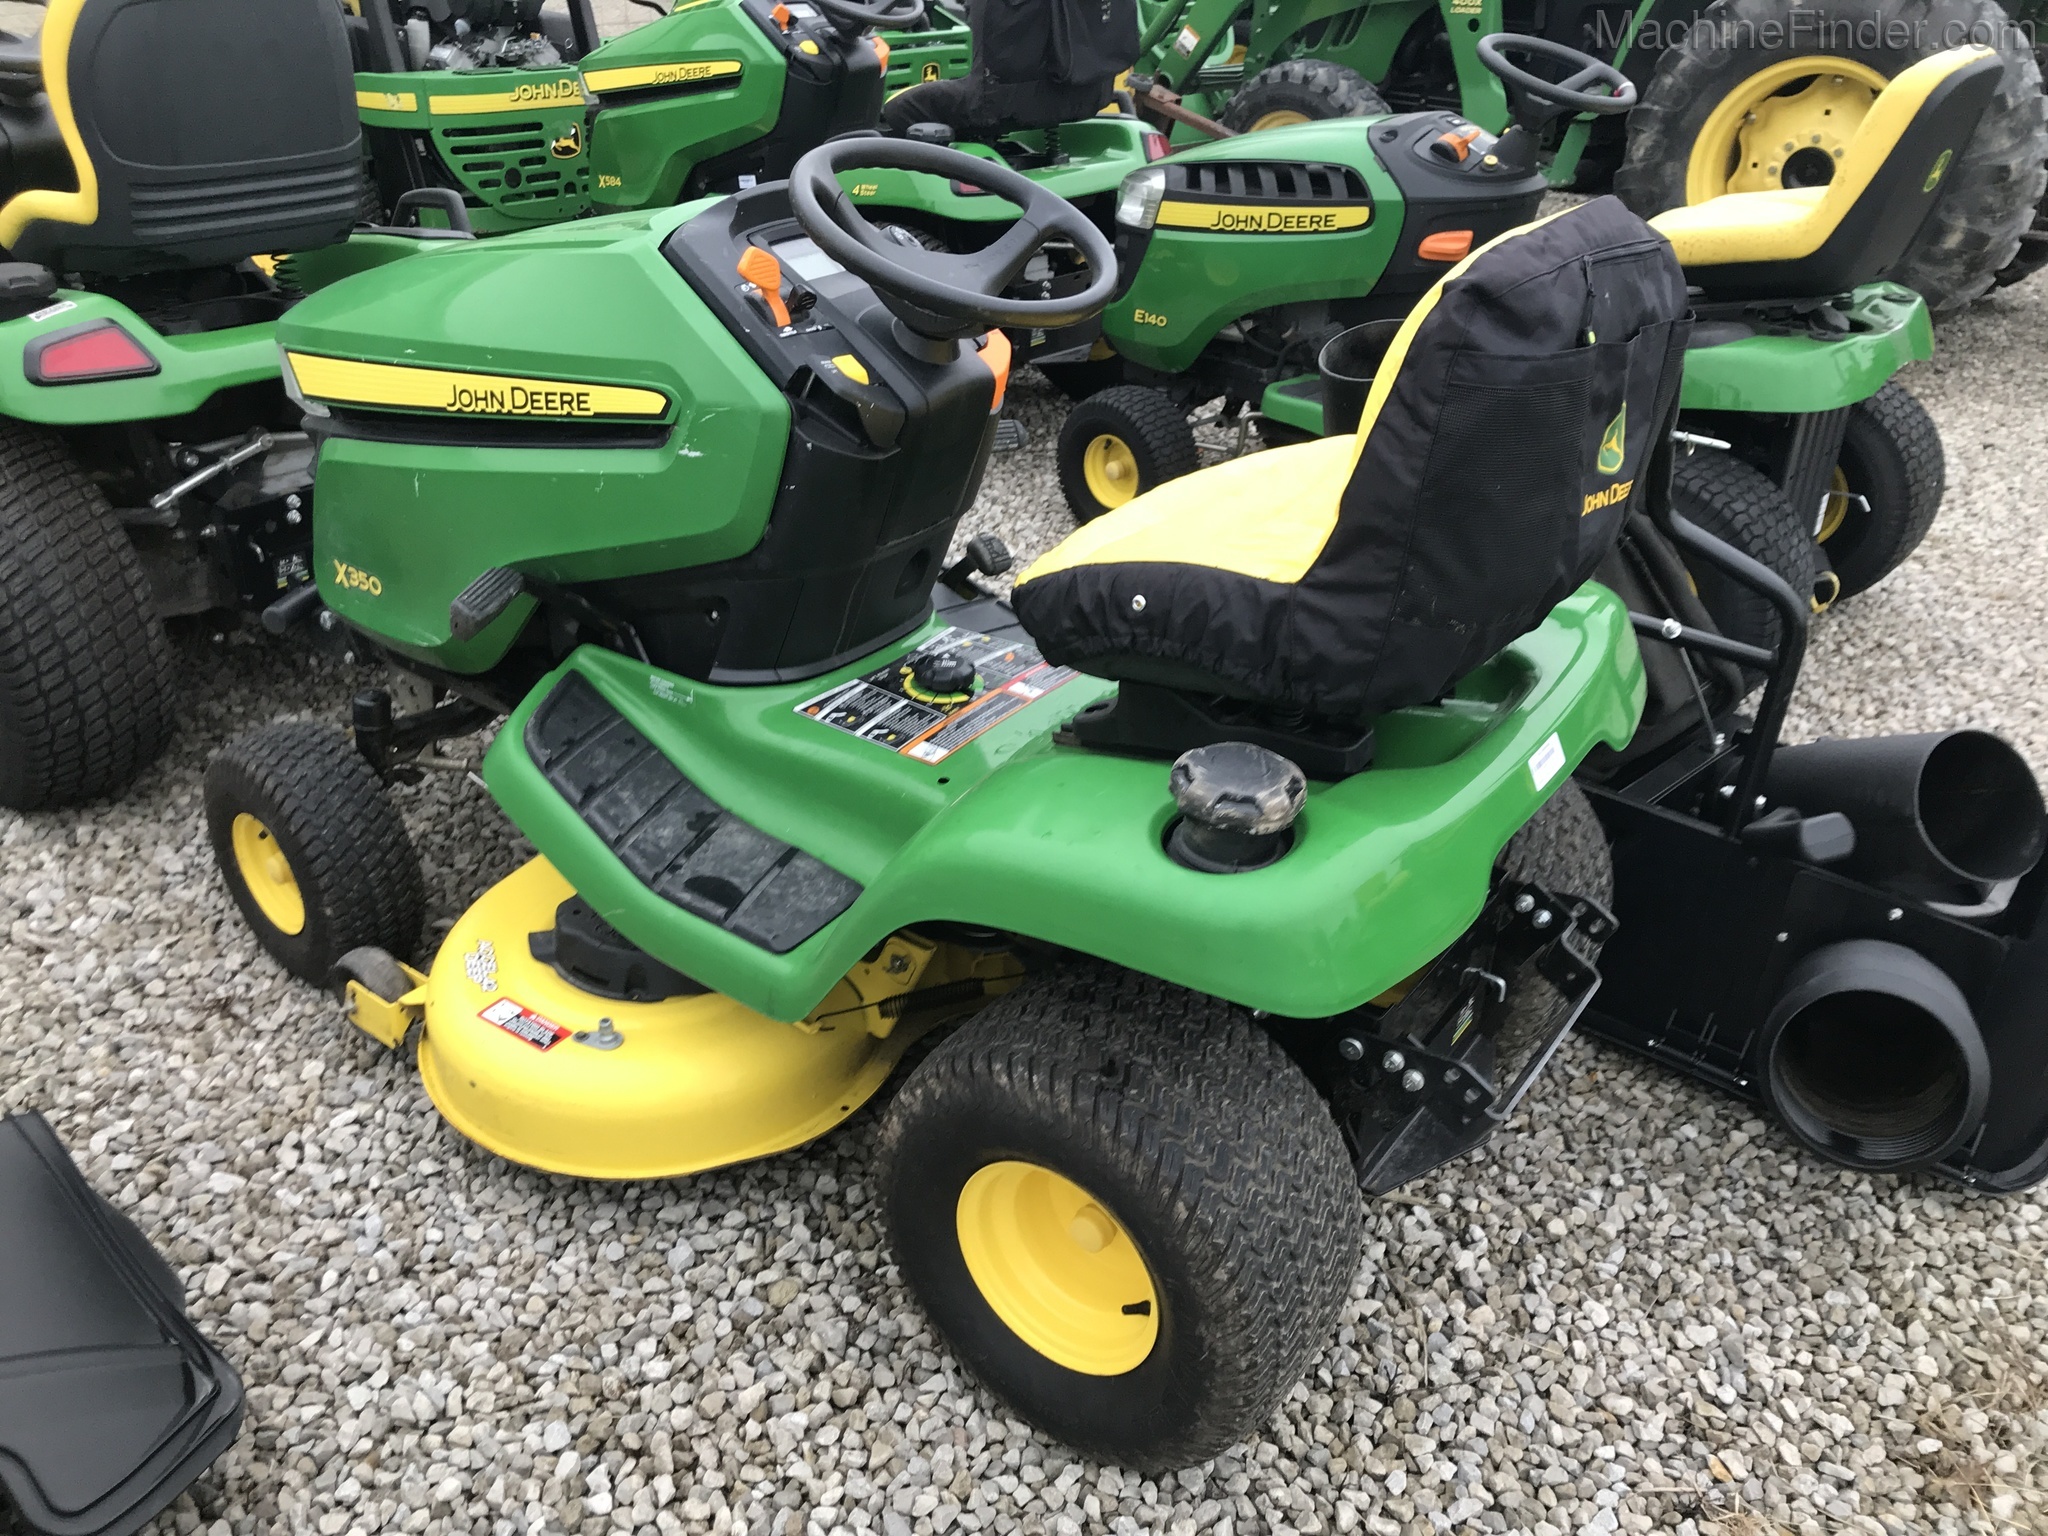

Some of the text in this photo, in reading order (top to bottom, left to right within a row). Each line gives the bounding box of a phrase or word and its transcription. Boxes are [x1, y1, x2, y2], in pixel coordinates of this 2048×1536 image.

[651, 65, 712, 84] JOHN DEERE
[510, 84, 557, 102] JOHN
[598, 174, 622, 188] X584
[851, 184, 861, 196] 4
[1210, 210, 1337, 230] JOHN DEERE
[1134, 309, 1167, 327] E140
[446, 384, 592, 412] JOHN DEERE
[1580, 488, 1610, 518] JOHN
[333, 558, 382, 596] X350
